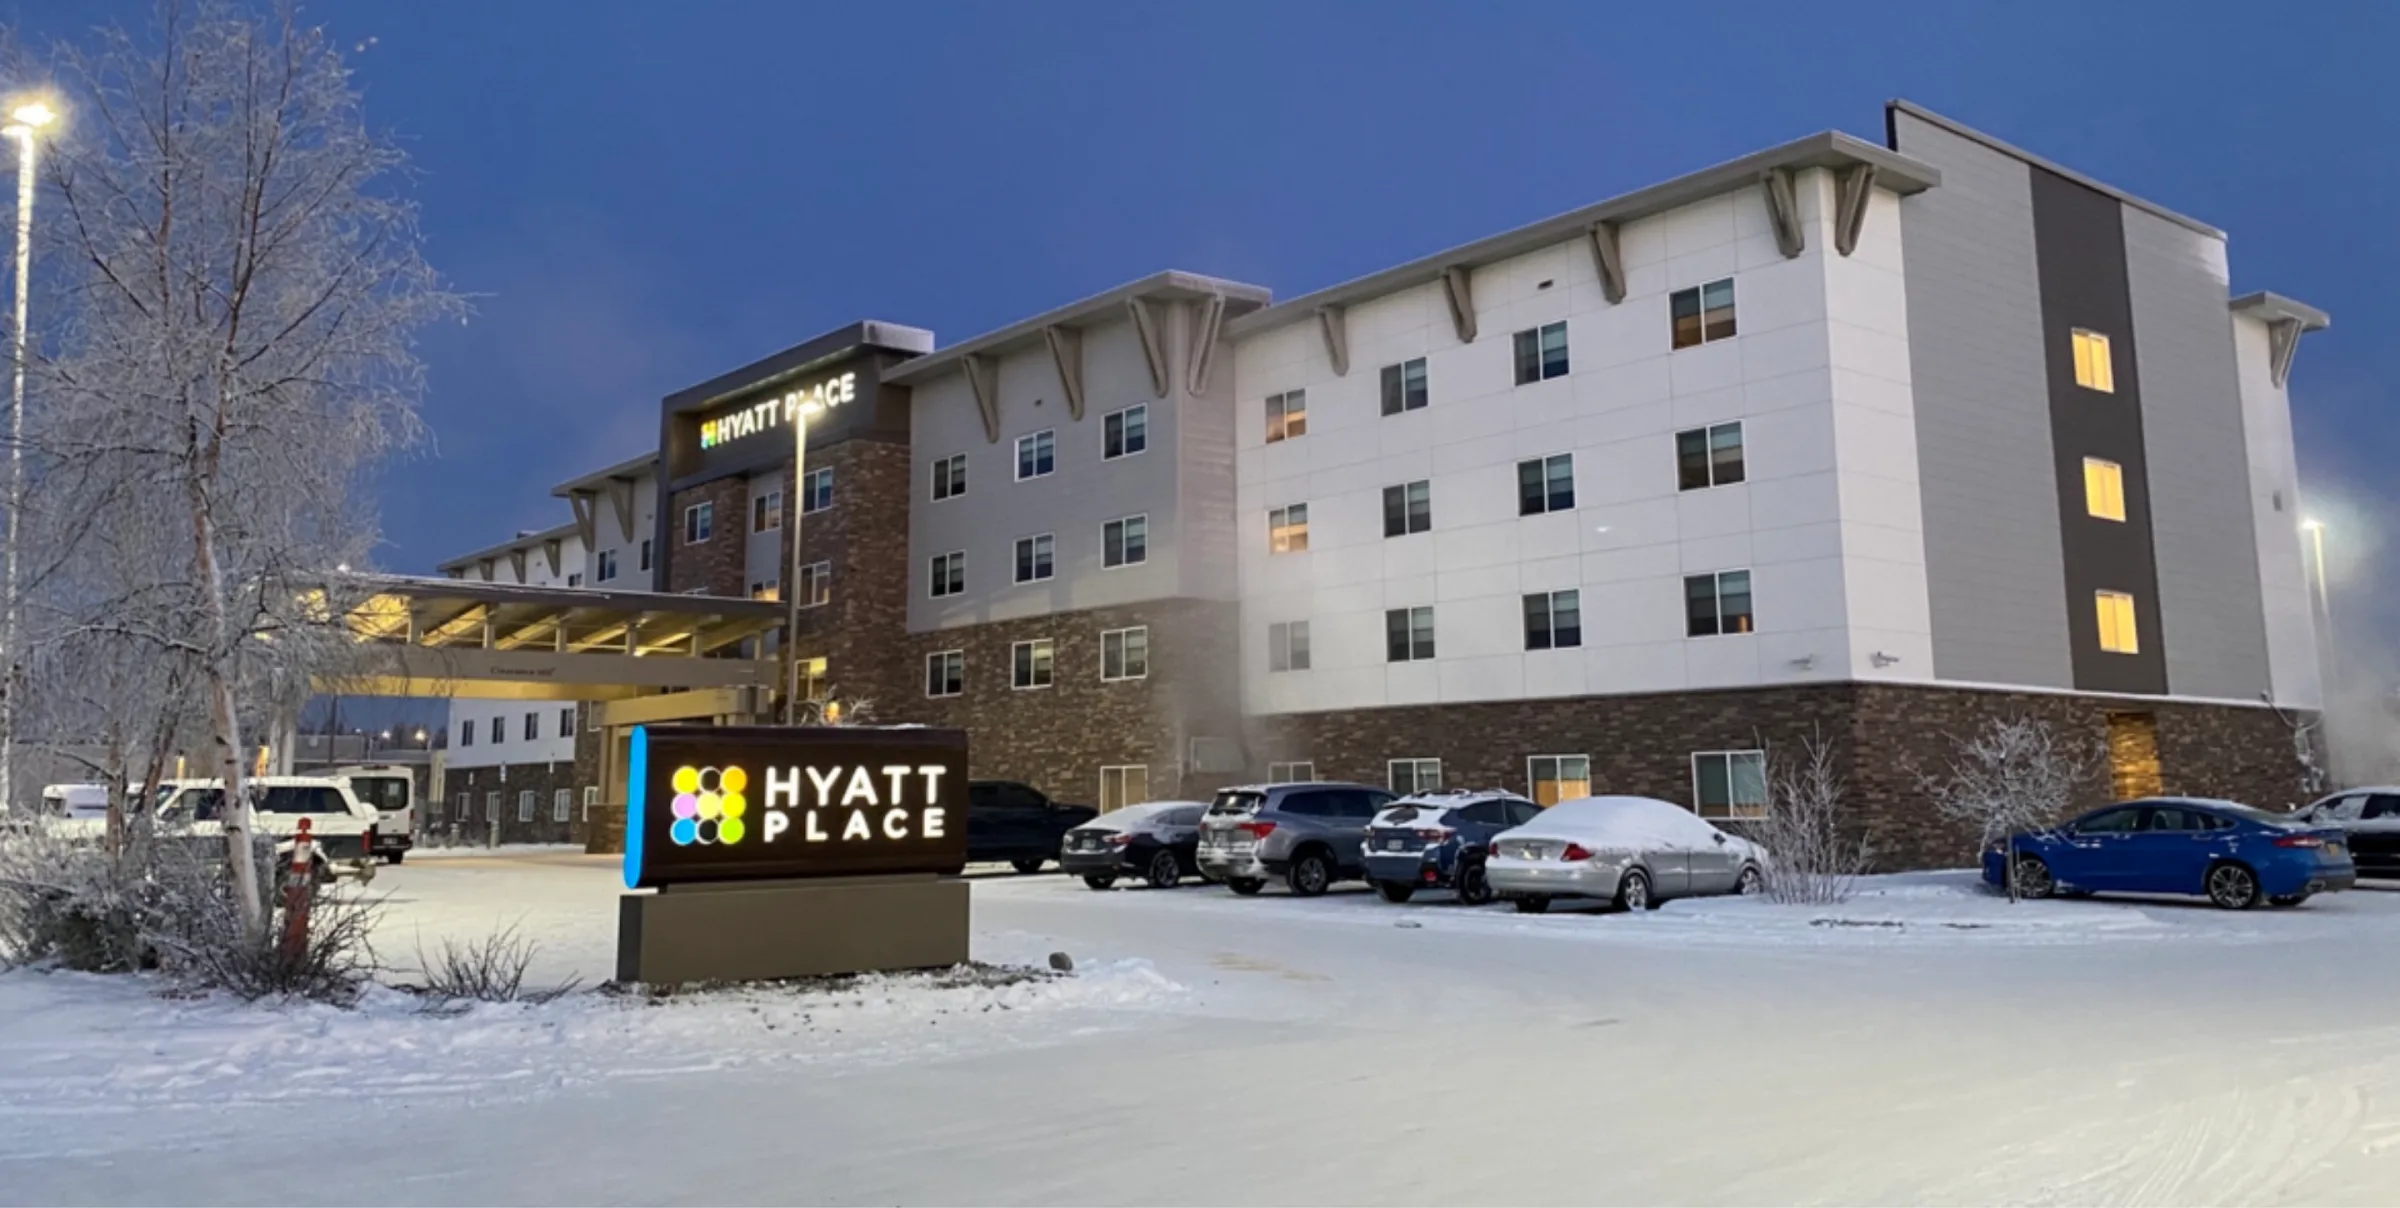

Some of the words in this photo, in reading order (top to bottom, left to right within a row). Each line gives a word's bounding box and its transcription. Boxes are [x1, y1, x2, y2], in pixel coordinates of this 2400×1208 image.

[717, 399, 780, 444] HYATT
[764, 765, 947, 807] HYATT
[763, 808, 946, 843] PLACE
